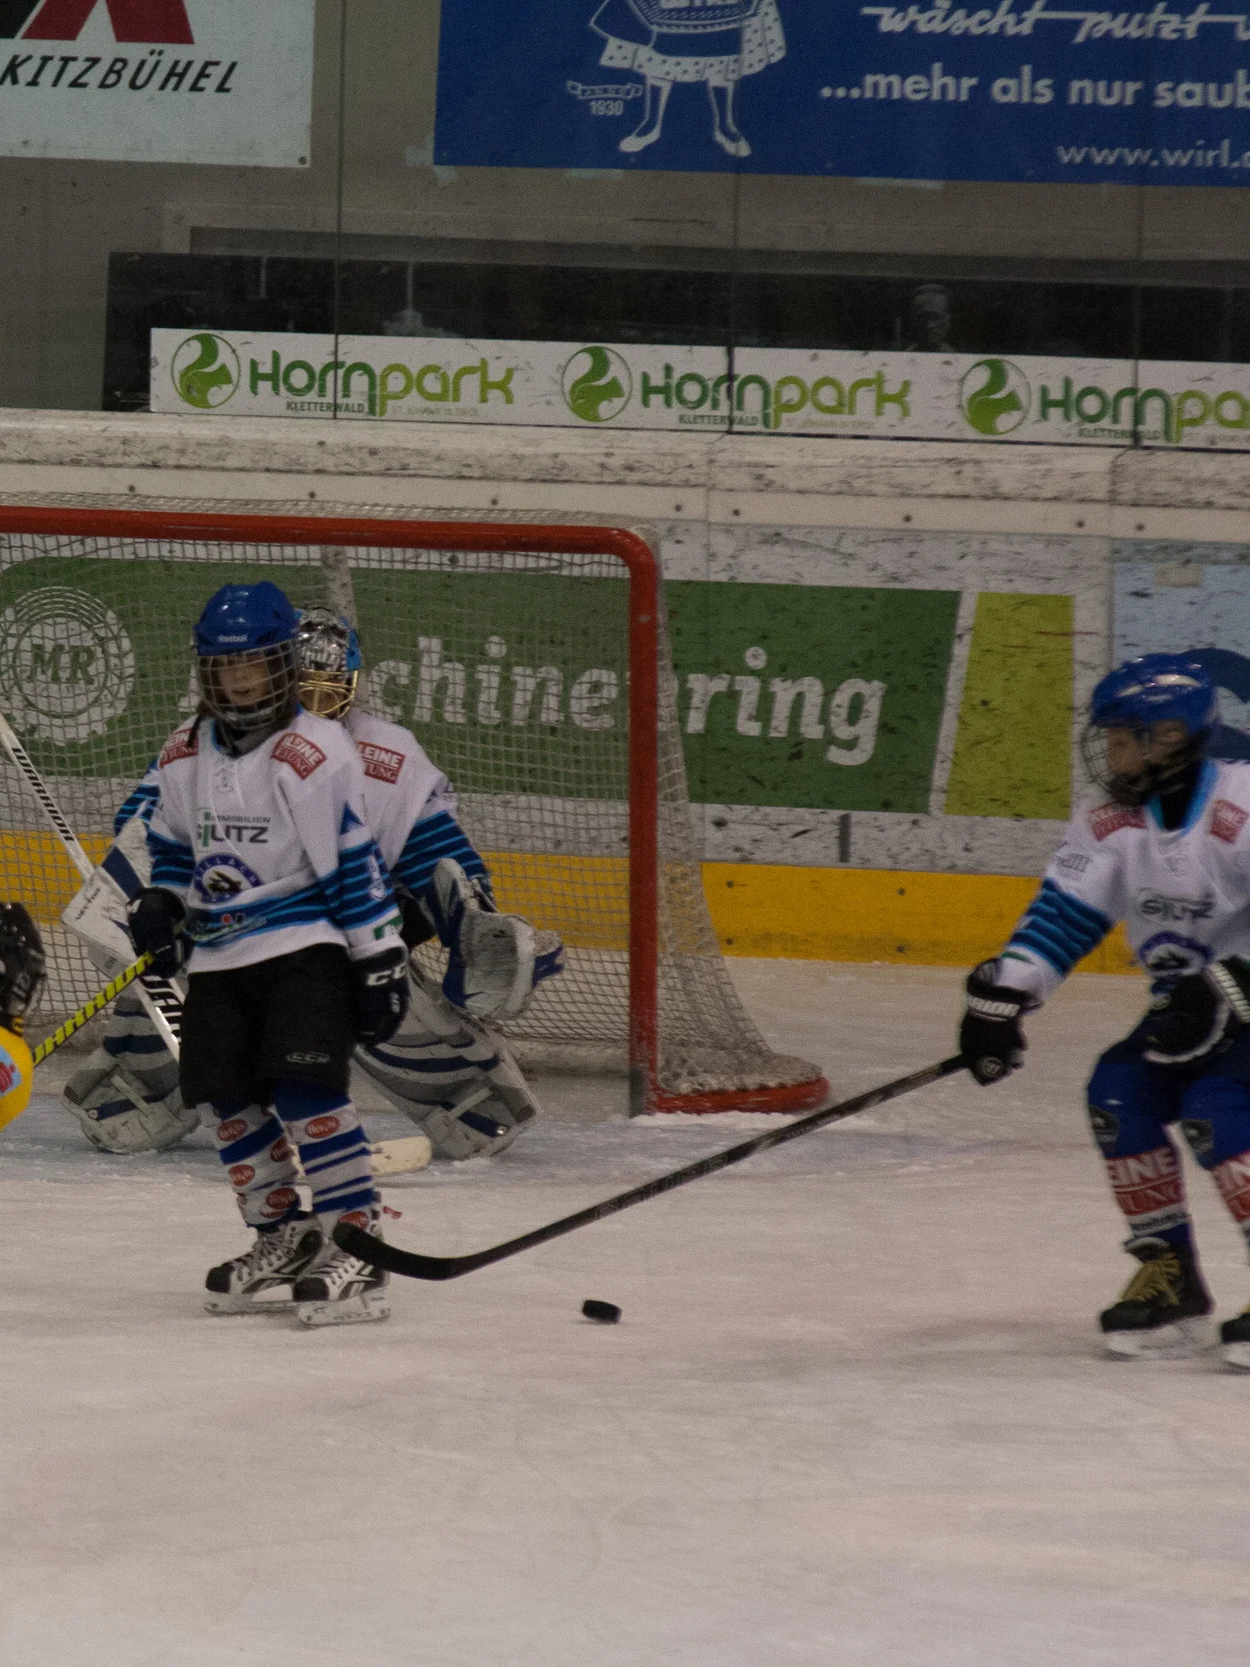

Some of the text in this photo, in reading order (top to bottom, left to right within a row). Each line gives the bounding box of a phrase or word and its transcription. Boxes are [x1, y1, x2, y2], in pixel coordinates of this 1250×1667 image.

[590, 100, 624, 115] 1930
[990, 65, 1054, 105] als
[1068, 79, 1143, 107] nur
[249, 349, 515, 417] Hornpark
[642, 363, 911, 429] Hornpark
[25, 643, 98, 688] MR
